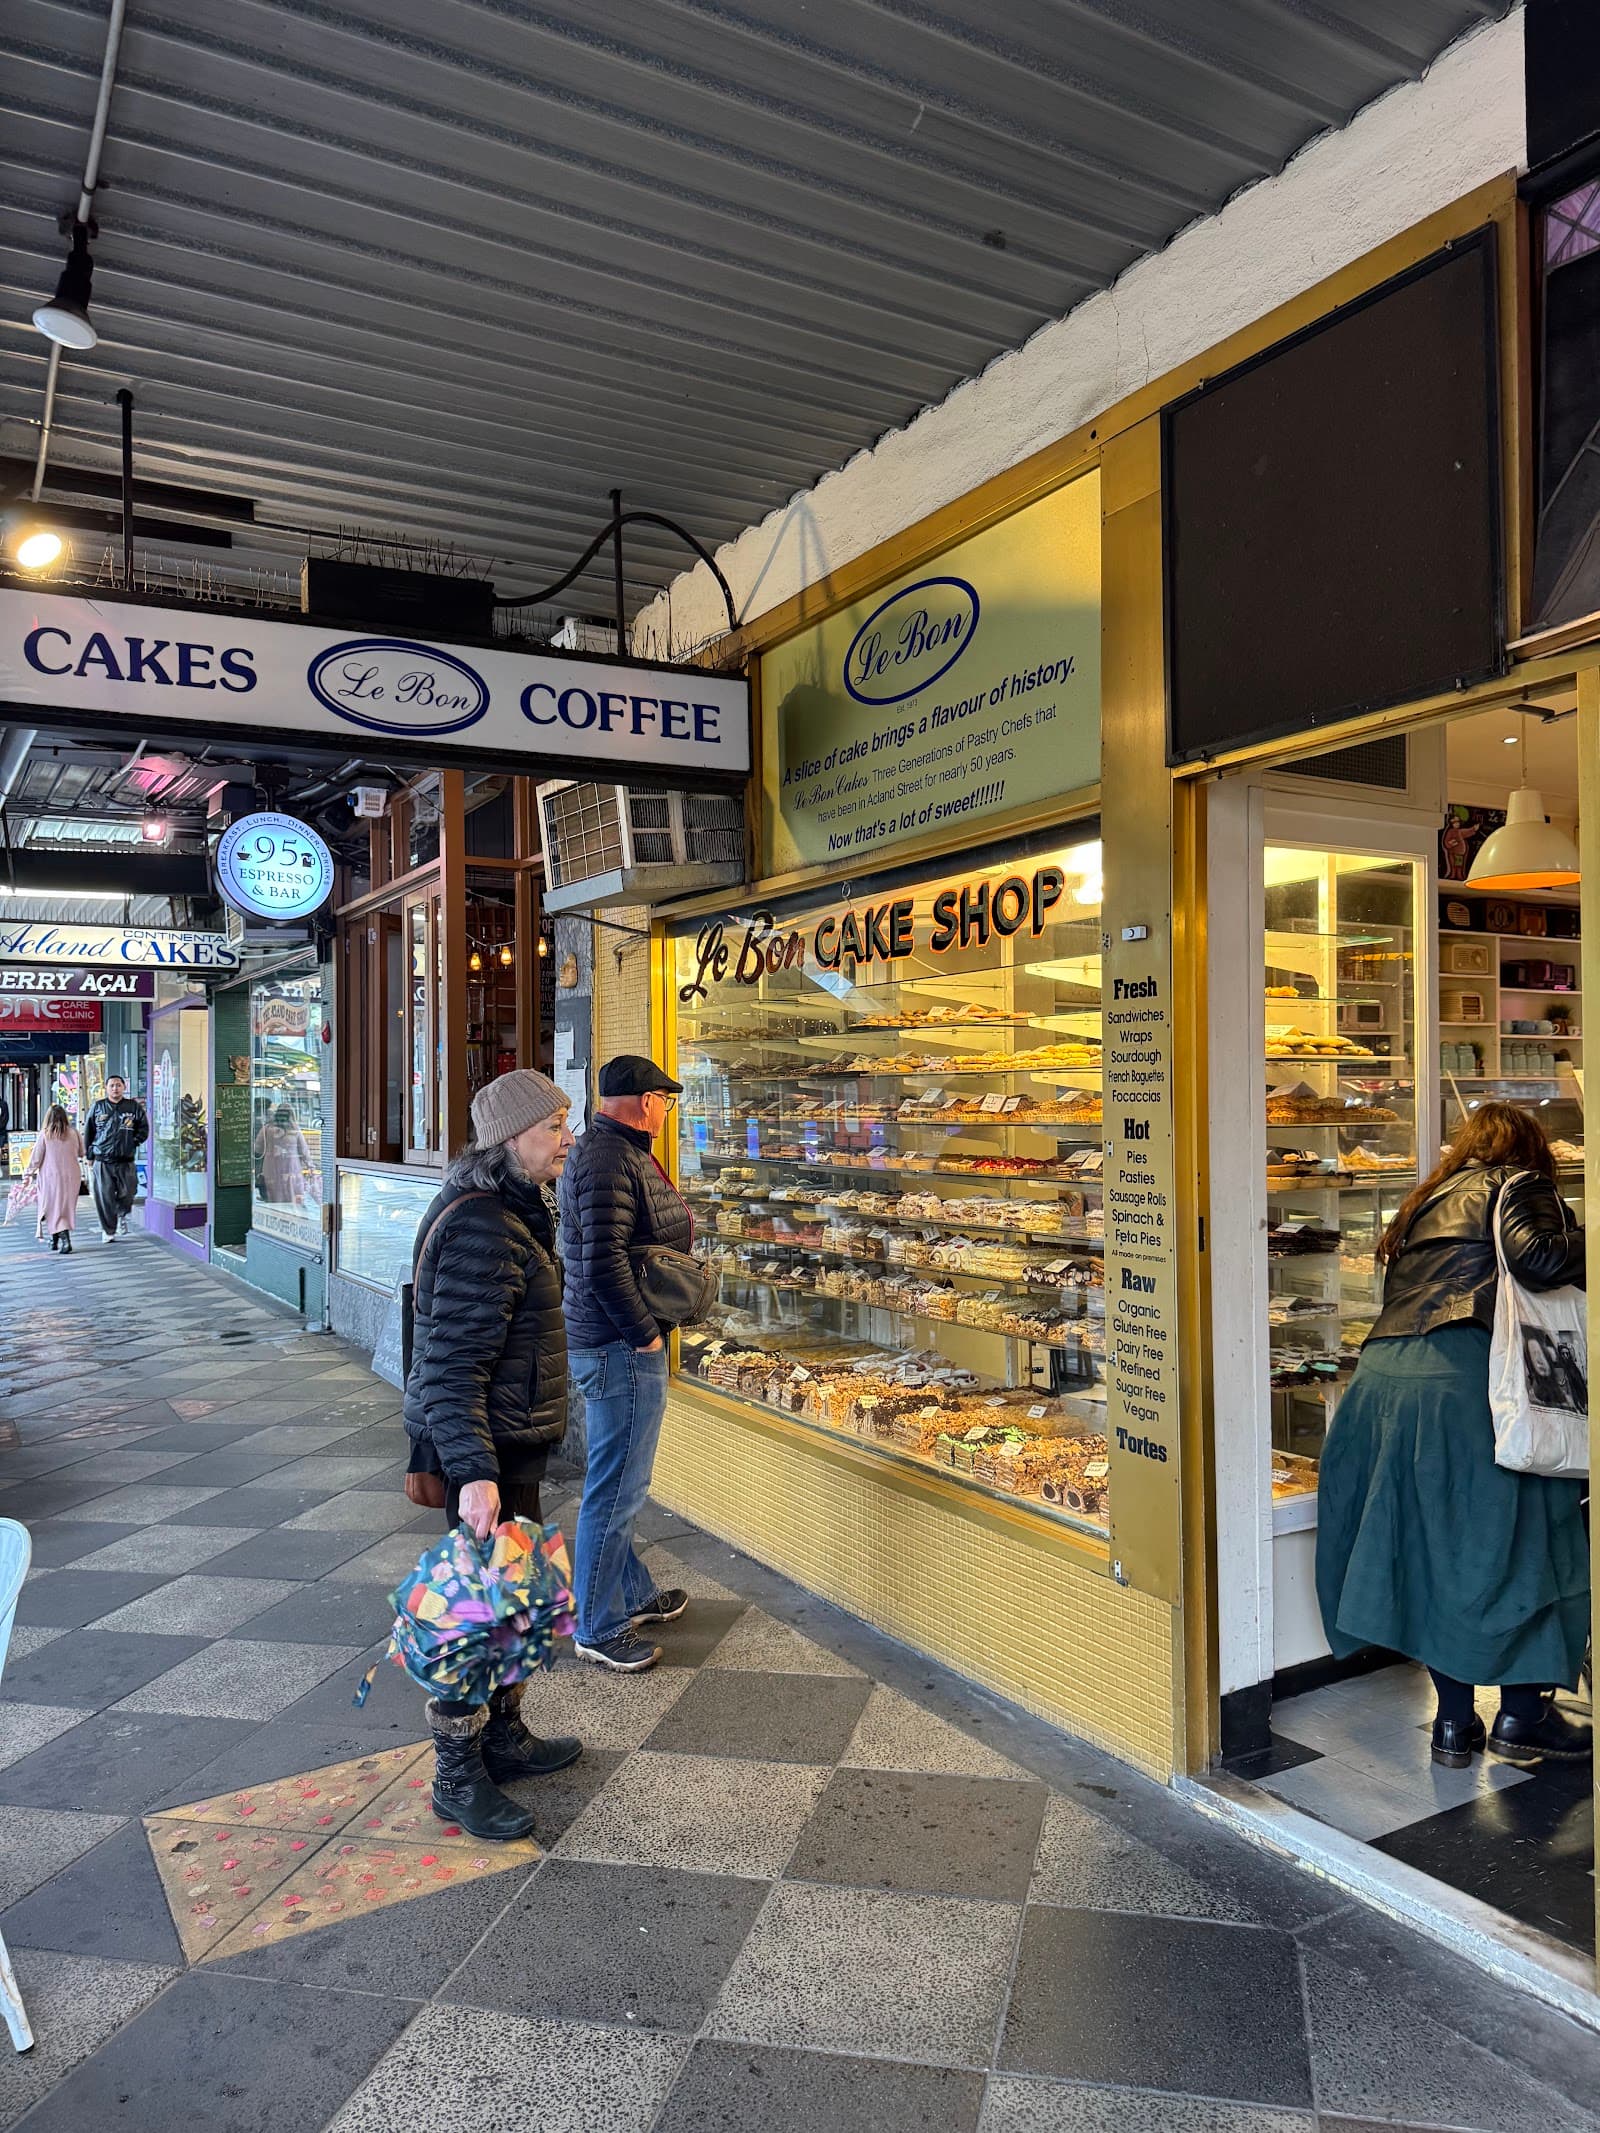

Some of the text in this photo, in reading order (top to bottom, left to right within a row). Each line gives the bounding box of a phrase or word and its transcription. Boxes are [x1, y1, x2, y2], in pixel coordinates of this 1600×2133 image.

[854, 608, 971, 686] Le Bon
[24, 627, 257, 693] CAKES
[338, 662, 471, 710] Le Bon
[520, 683, 721, 743] COFFEE
[783, 656, 1075, 788] A slice of cake brings a flavour of history.
[793, 703, 1057, 811] Le Bon Cakes Three Generations of Pastry Chefs that
[818, 747, 1017, 824] have been in Acland Street for nearly 50 years.
[828, 780, 1004, 851] Now that's a lot of sweet!!!!!!
[255, 836, 298, 866] 95
[240, 868, 314, 885] ESPRESSO
[252, 885, 301, 899] & BAR
[0, 924, 236, 966] Acland CAKES
[123, 930, 226, 943] CONTINENTA
[679, 865, 1065, 1003] Le Bon CAKE SHOP
[0, 971, 138, 997] ERRY AÇAI
[1114, 976, 1157, 1000] Fresh
[62, 1001, 90, 1009] CARE
[62, 1011, 95, 1019] CLINIC
[1108, 1008, 1164, 1024] Sandwiches
[1119, 1030, 1153, 1045] Wraps
[1111, 1049, 1162, 1065] Sourdough
[1108, 1069, 1165, 1085] French Baguettes
[1112, 1090, 1161, 1102] Focaccias
[1124, 1118, 1150, 1140] Hot
[1127, 1150, 1147, 1164] Pies
[1120, 1170, 1155, 1185] Pasties
[1109, 1188, 1167, 1207] Sausage Rolls
[1112, 1209, 1165, 1226] Spinach &
[1115, 1229, 1161, 1246] Feta Pies
[1118, 1250, 1134, 1259] made
[1143, 1253, 1167, 1264] premises
[1121, 1267, 1156, 1293] Raw
[1118, 1300, 1161, 1320] Organic
[1113, 1318, 1167, 1341] Gluten Free
[1116, 1339, 1164, 1361] Dairy Free
[1120, 1359, 1161, 1381] Refined
[1116, 1379, 1166, 1403] Sugar Free
[1123, 1400, 1159, 1422] Vegan
[1116, 1426, 1167, 1463] Tortes
